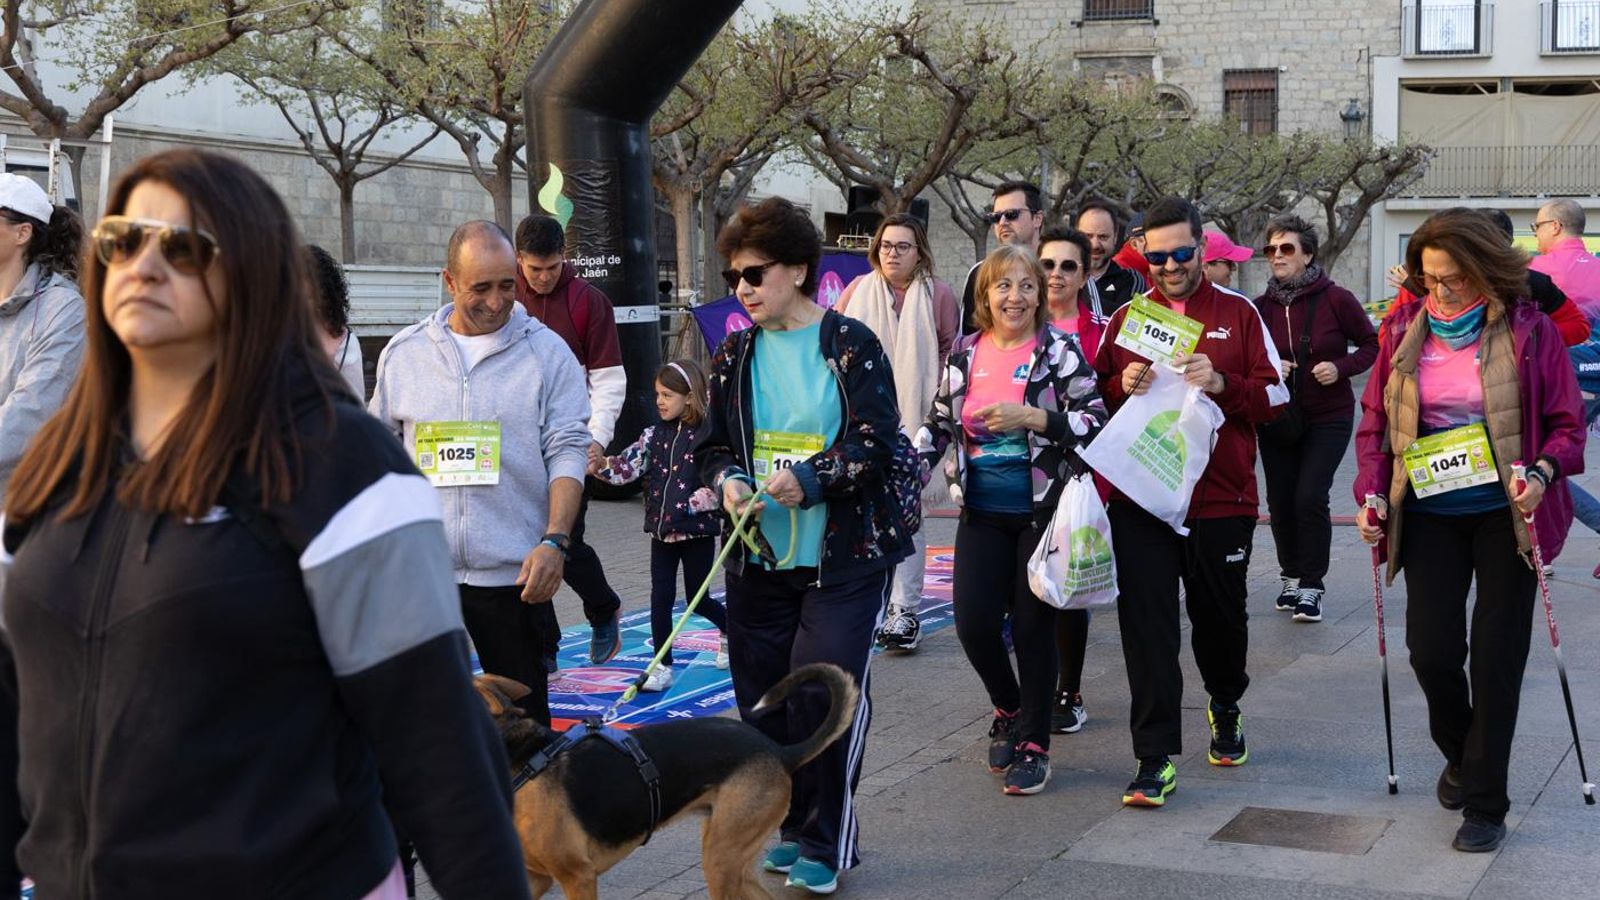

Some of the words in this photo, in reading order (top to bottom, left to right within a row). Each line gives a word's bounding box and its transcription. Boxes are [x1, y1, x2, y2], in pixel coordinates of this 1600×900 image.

[569, 254, 605, 267] nicipal
[607, 255, 621, 265] de
[582, 267, 608, 278] Jaén
[1144, 324, 1177, 346] 1051
[438, 447, 475, 461] 1025
[1430, 453, 1468, 472] 1047
